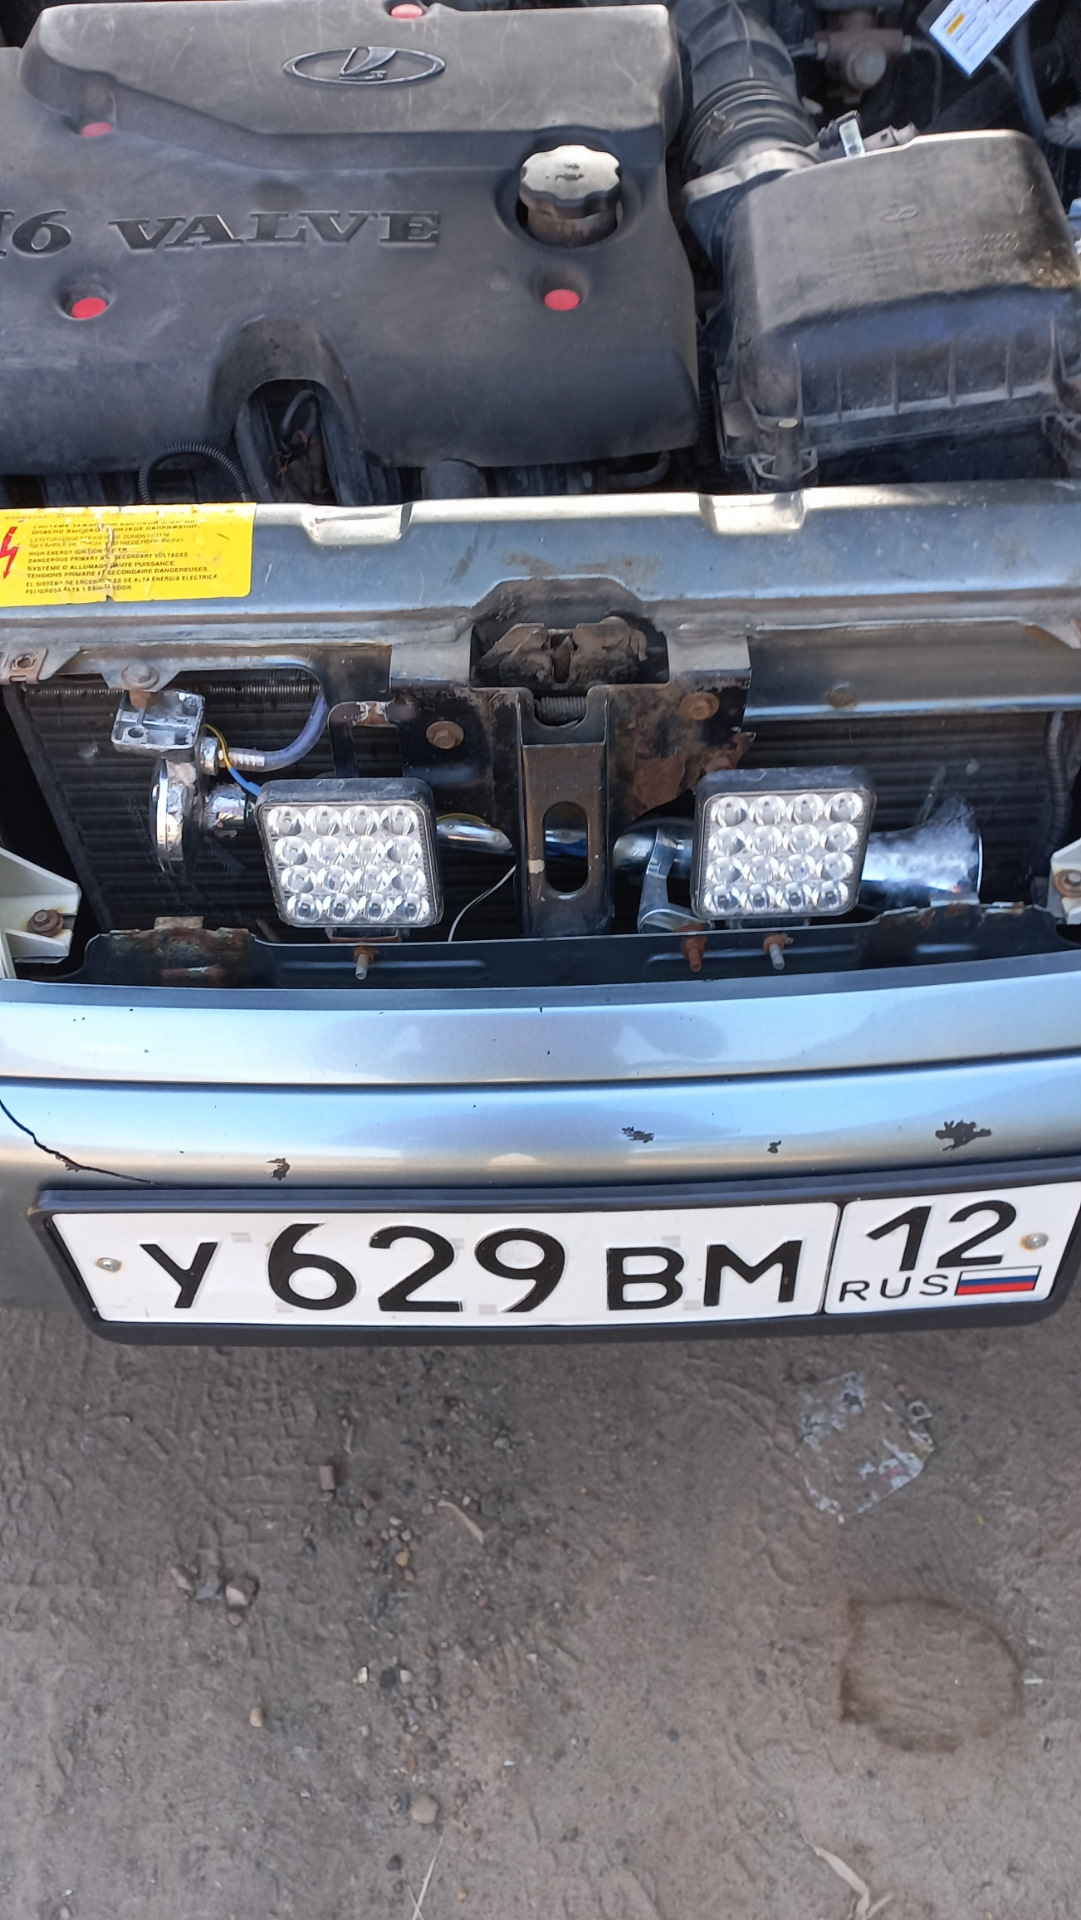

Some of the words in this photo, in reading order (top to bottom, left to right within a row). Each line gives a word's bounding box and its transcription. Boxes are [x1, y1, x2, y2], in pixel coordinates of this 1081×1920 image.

[108, 209, 441, 252] VALVE
[866, 1199, 1017, 1272] 12
[267, 1223, 567, 1313] 629
[838, 1273, 949, 1303] RUS
